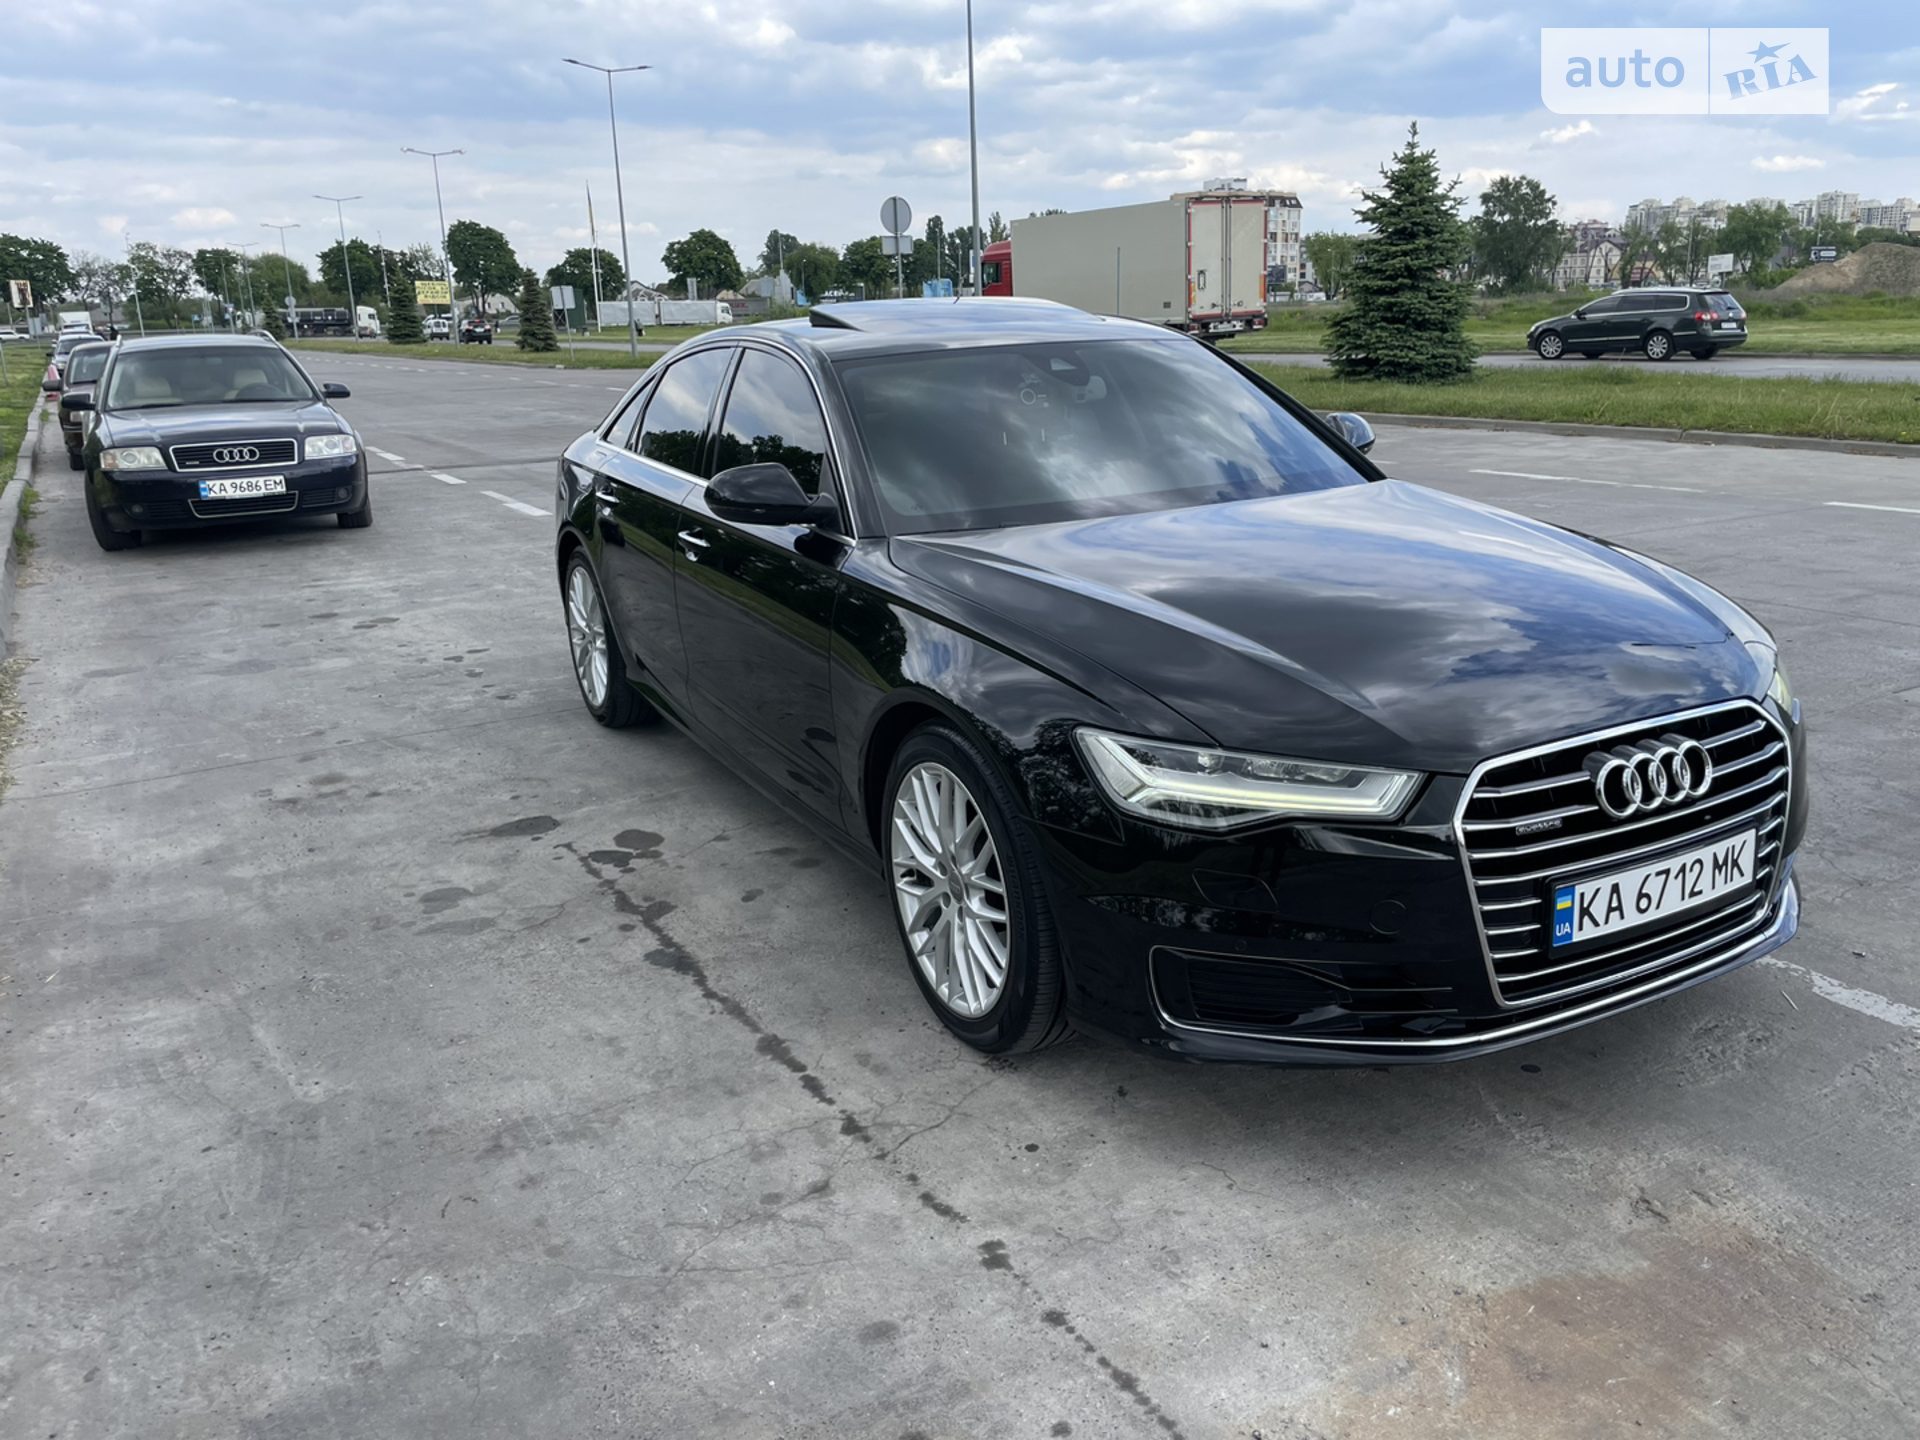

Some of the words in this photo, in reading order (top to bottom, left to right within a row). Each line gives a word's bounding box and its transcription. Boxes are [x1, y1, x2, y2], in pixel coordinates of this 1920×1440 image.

[207, 482, 228, 495] KA
[230, 480, 262, 494] 9686
[263, 478, 284, 491] EM
[1578, 882, 1625, 932] KA
[1635, 857, 1704, 915] 6712
[1711, 839, 1747, 891] MK
[1555, 922, 1571, 938] UA
